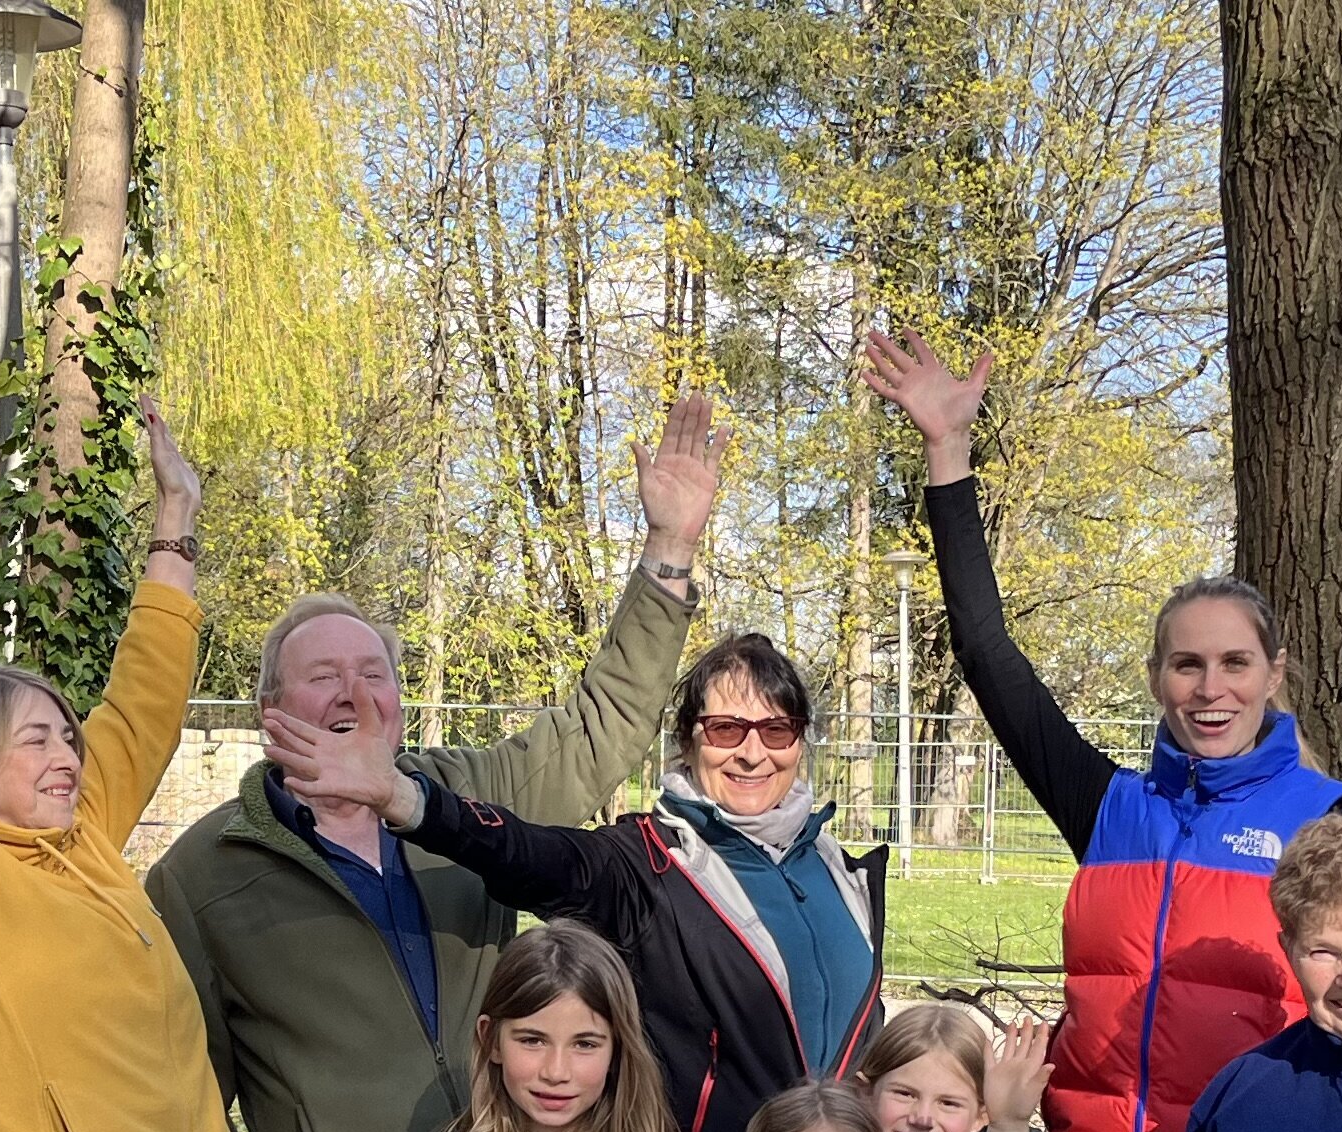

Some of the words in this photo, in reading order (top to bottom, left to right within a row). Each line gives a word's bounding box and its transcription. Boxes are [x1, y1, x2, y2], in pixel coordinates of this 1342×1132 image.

[1242, 826, 1265, 840] THE
[1221, 833, 1264, 848] NORTH
[1232, 844, 1263, 858] FACE
